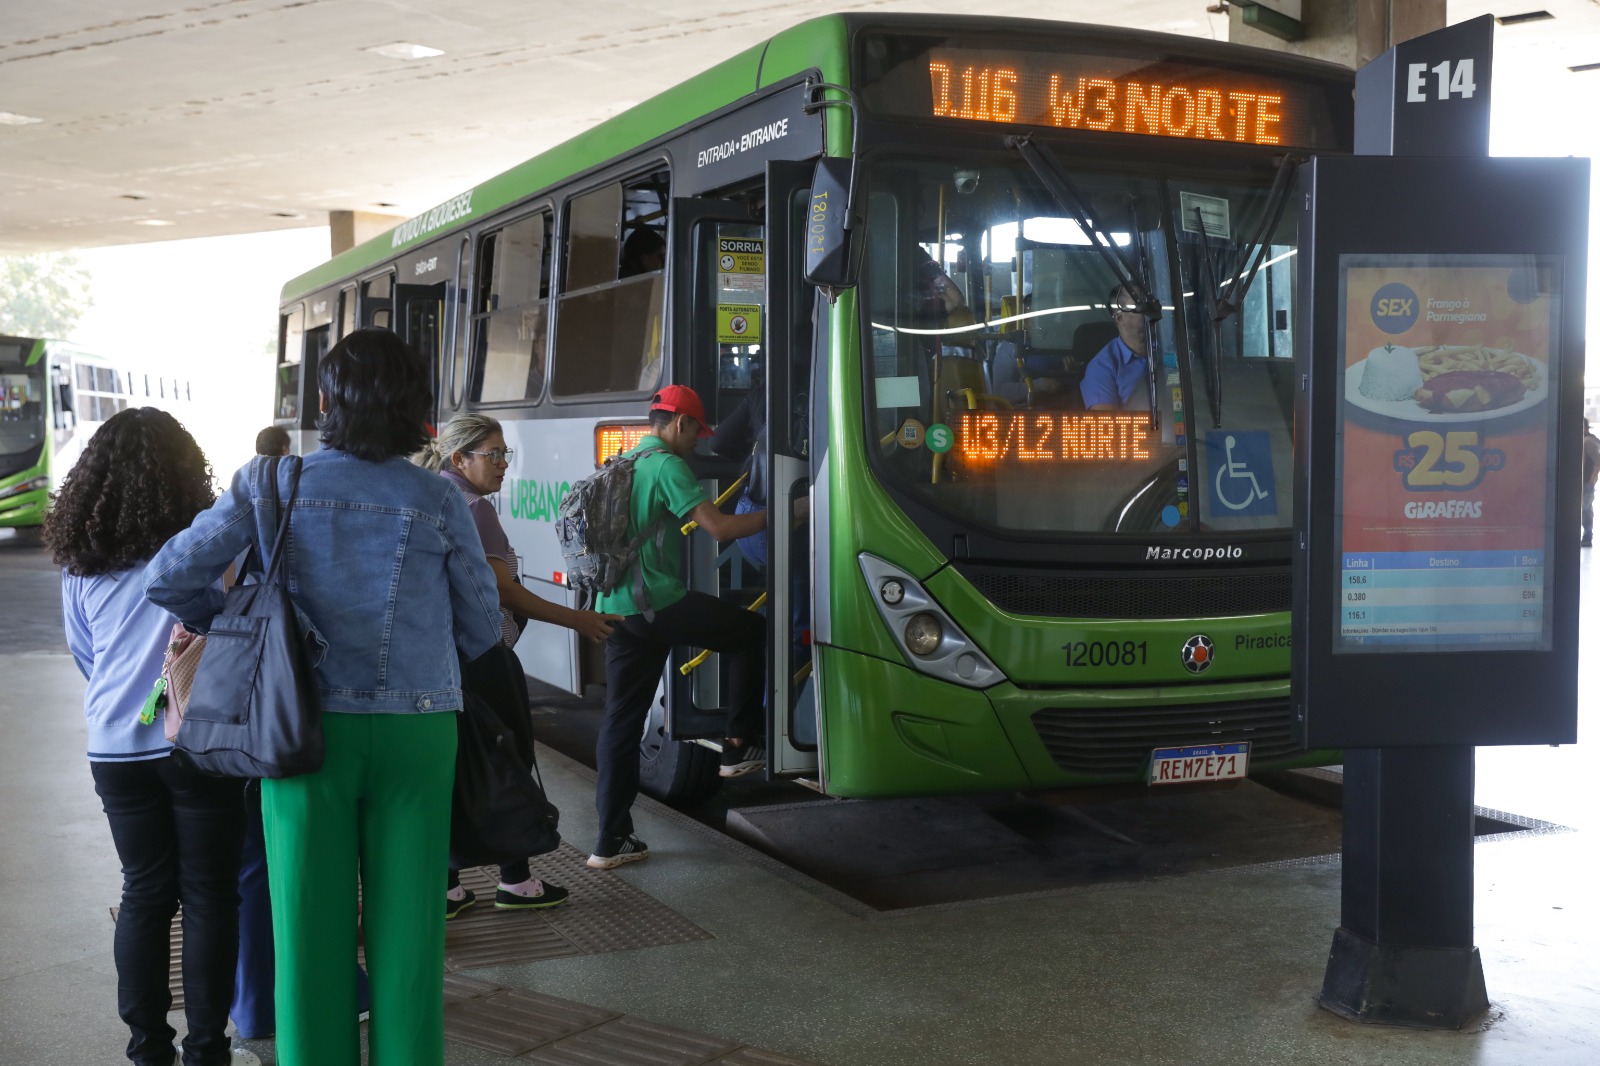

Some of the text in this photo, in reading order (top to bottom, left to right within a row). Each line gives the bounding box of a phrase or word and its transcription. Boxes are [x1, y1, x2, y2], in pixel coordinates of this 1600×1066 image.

[1050, 75, 1116, 131] W3
[1125, 82, 1282, 145] NORTE
[720, 240, 763, 253] SORRIA
[1376, 298, 1413, 317] SEX
[1426, 298, 1462, 311] Frango
[1426, 310, 1487, 325] Parmegiana
[932, 428, 948, 448] S
[1061, 415, 1150, 459] NORTE
[1145, 545, 1243, 561] Marcopolo
[1522, 555, 1538, 566] Box
[1346, 558, 1369, 568] Linha
[1061, 640, 1148, 667] 120081
